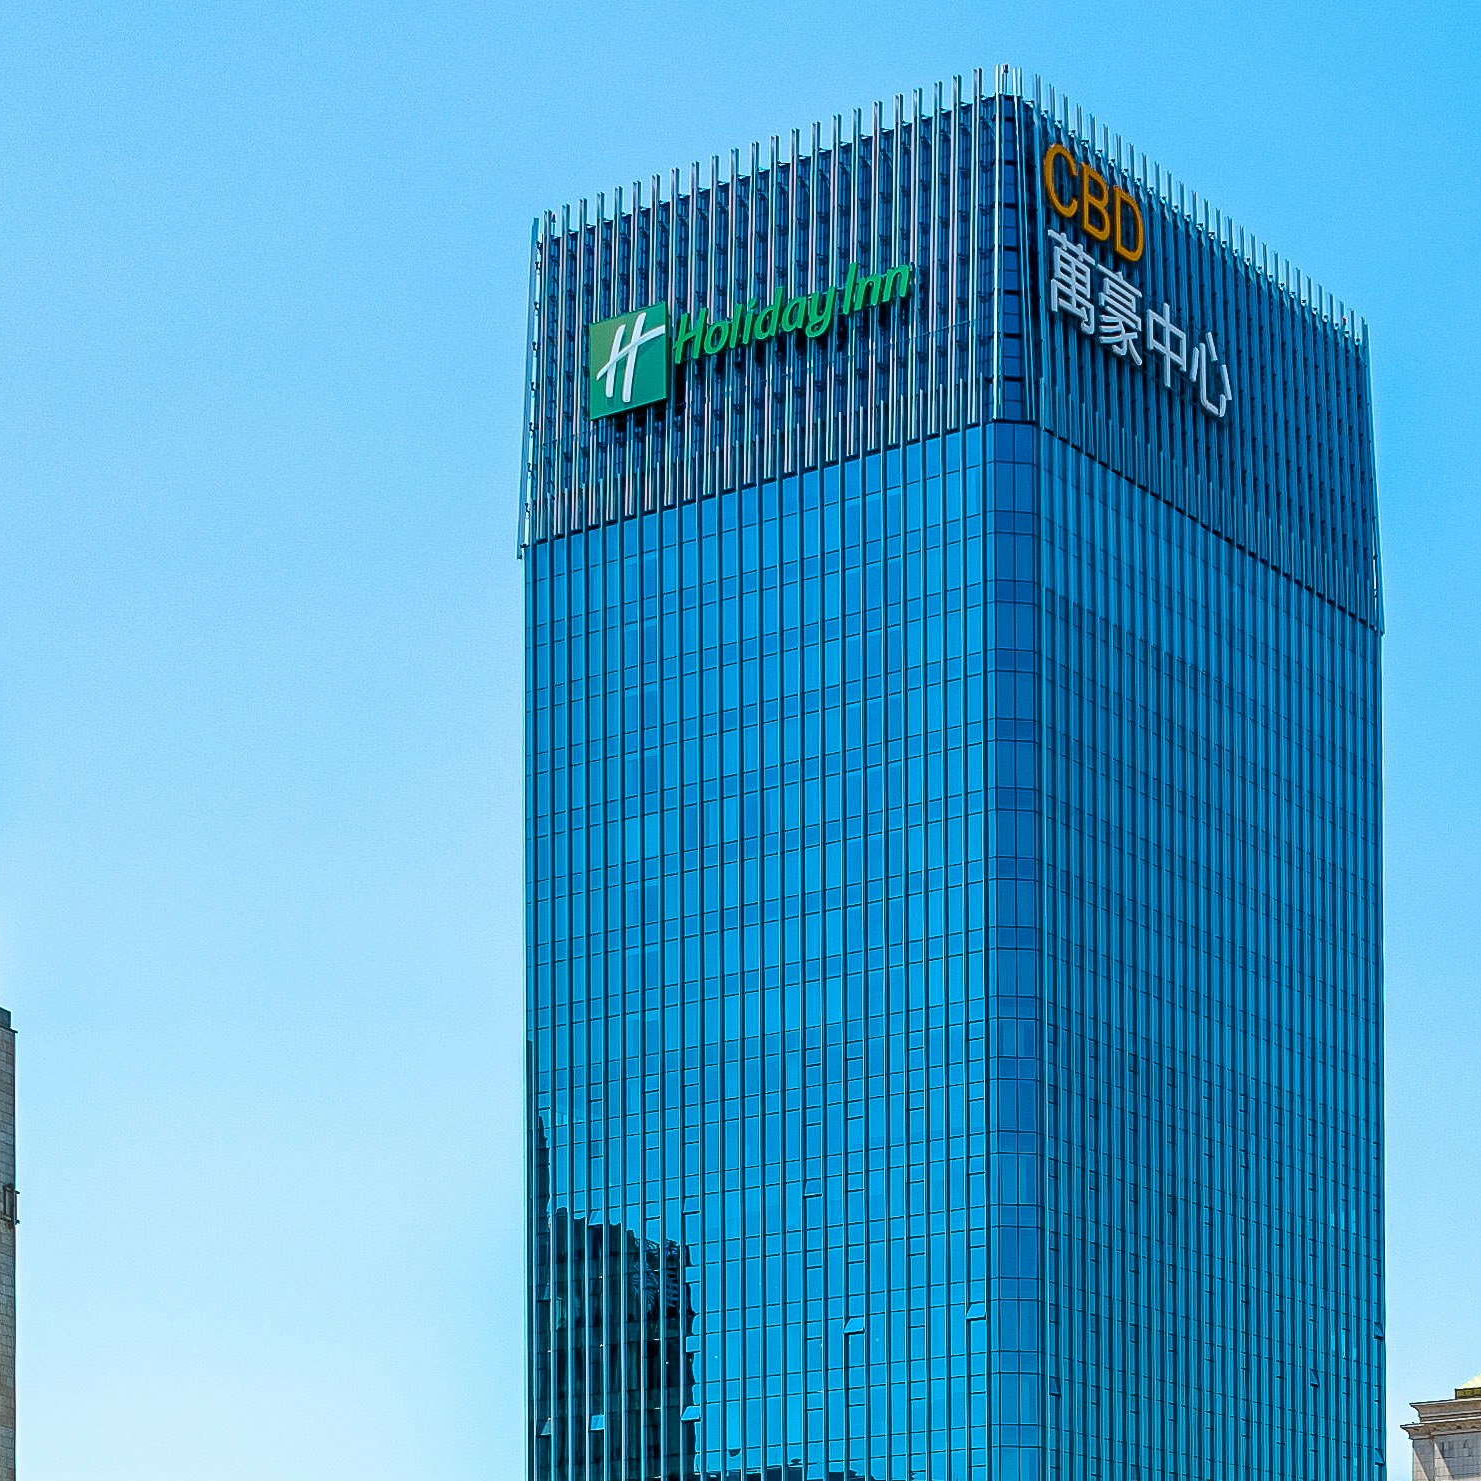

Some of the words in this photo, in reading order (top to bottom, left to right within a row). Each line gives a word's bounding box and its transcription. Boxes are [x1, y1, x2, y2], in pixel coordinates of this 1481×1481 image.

[1043, 143, 1145, 263] CBD
[672, 285, 835, 364] Holiday
[842, 262, 912, 315] Inn
[1047, 228, 1233, 418] 萬豪中心
